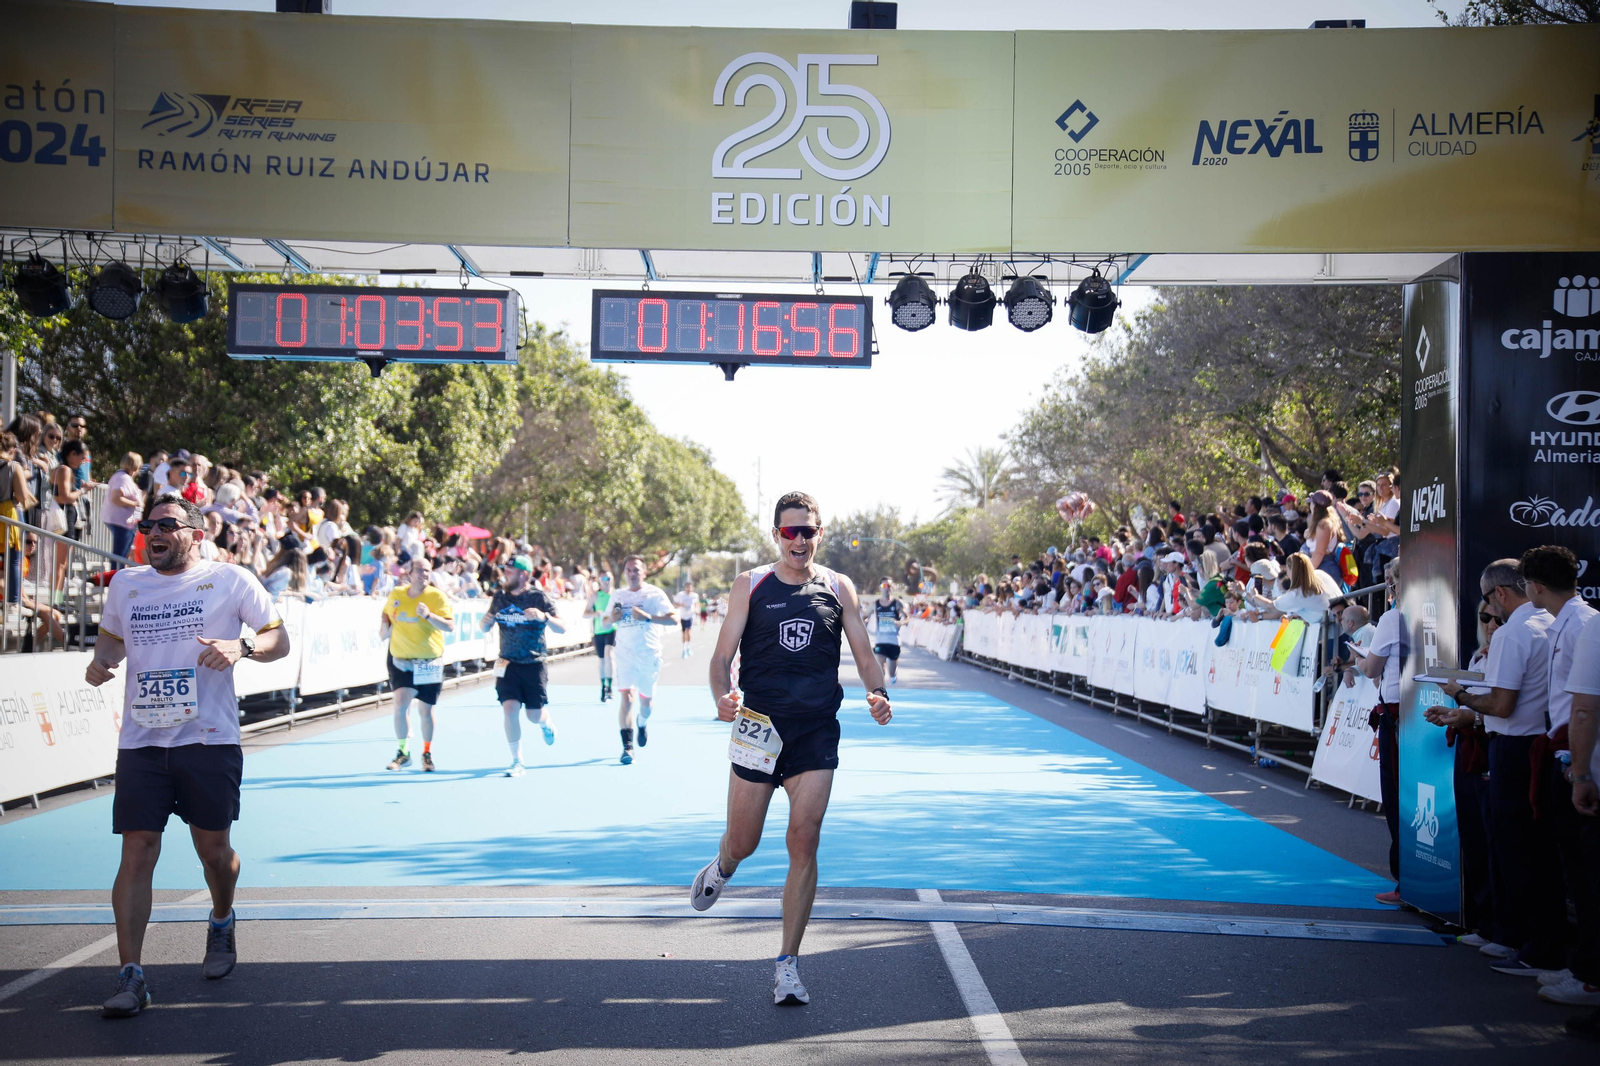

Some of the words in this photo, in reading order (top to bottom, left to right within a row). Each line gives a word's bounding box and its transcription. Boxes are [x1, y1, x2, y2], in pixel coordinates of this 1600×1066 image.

[4, 78, 105, 114] atón
[231, 98, 303, 115] RFEA
[712, 52, 892, 181] 25
[224, 115, 296, 130] SERIES
[1408, 105, 1545, 137] ALMERÍA
[0, 119, 106, 167] 024
[217, 128, 264, 141] RUTA
[267, 131, 337, 143] RUNNING
[1192, 111, 1323, 166] NEXAL
[1054, 147, 1165, 162] COOPERACIÓN
[1407, 140, 1478, 157] CIUDAD
[138, 147, 250, 175] RAMÓN
[266, 155, 336, 178] RUIZ
[347, 155, 491, 184] ANDÚJAR
[1054, 163, 1091, 176] 2005
[1202, 157, 1228, 166] 2020
[711, 187, 891, 227] EDICIÓN
[636, 297, 859, 358] 01:16:56
[1575, 351, 1600, 362] CAJ
[1410, 477, 1446, 533] NEXAL
[130, 611, 171, 621] Almería
[173, 606, 203, 618] 2024
[131, 605, 160, 613] Medio
[163, 599, 204, 611] Maratón
[172, 617, 204, 626] ANDÚJAR
[139, 679, 190, 699] 5456
[1344, 703, 1371, 732] ALMER
[738, 718, 773, 744] 521
